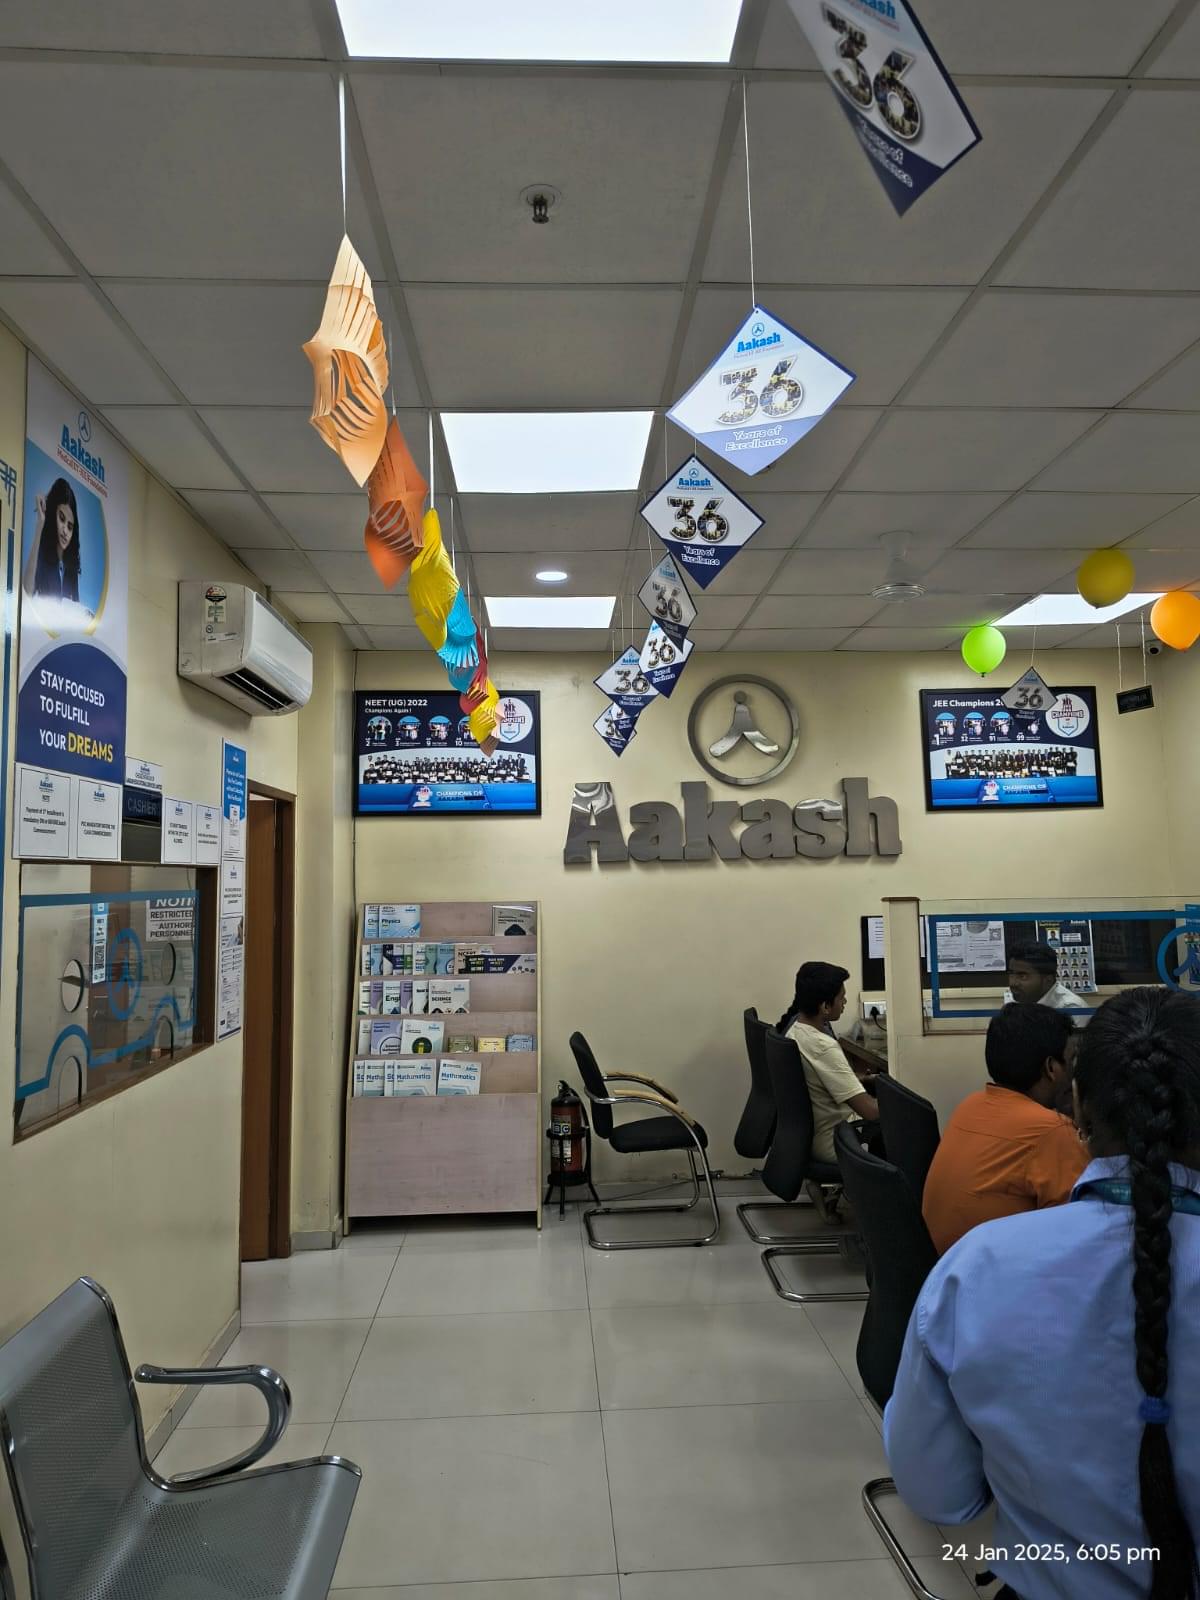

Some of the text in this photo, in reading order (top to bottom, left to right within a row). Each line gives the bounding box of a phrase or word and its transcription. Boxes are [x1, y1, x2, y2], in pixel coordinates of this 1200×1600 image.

[821, 3, 922, 139] 36
[737, 332, 780, 352] Aakash
[716, 354, 804, 425] 36
[725, 437, 788, 451] Excellence
[733, 424, 782, 440] Years of
[60, 424, 105, 483] Aakash
[678, 477, 711, 486] Aakash
[667, 496, 729, 542] 36
[652, 581, 682, 622] 36
[648, 635, 676, 668] 36
[40, 669, 105, 707] STAY FOCUSED
[614, 668, 650, 694] 36
[40, 694, 90, 726] TO FULFILL
[388, 699, 406, 708] (UG)
[933, 699, 948, 708] JEE
[949, 698, 994, 709] Champions
[1014, 686, 1043, 709] 36
[1052, 709, 1084, 719] CHAMPIONS
[40, 729, 113, 763] YOUR DREAMS
[563, 777, 902, 864] Aakash
[441, 1071, 476, 1081] Mathematics
